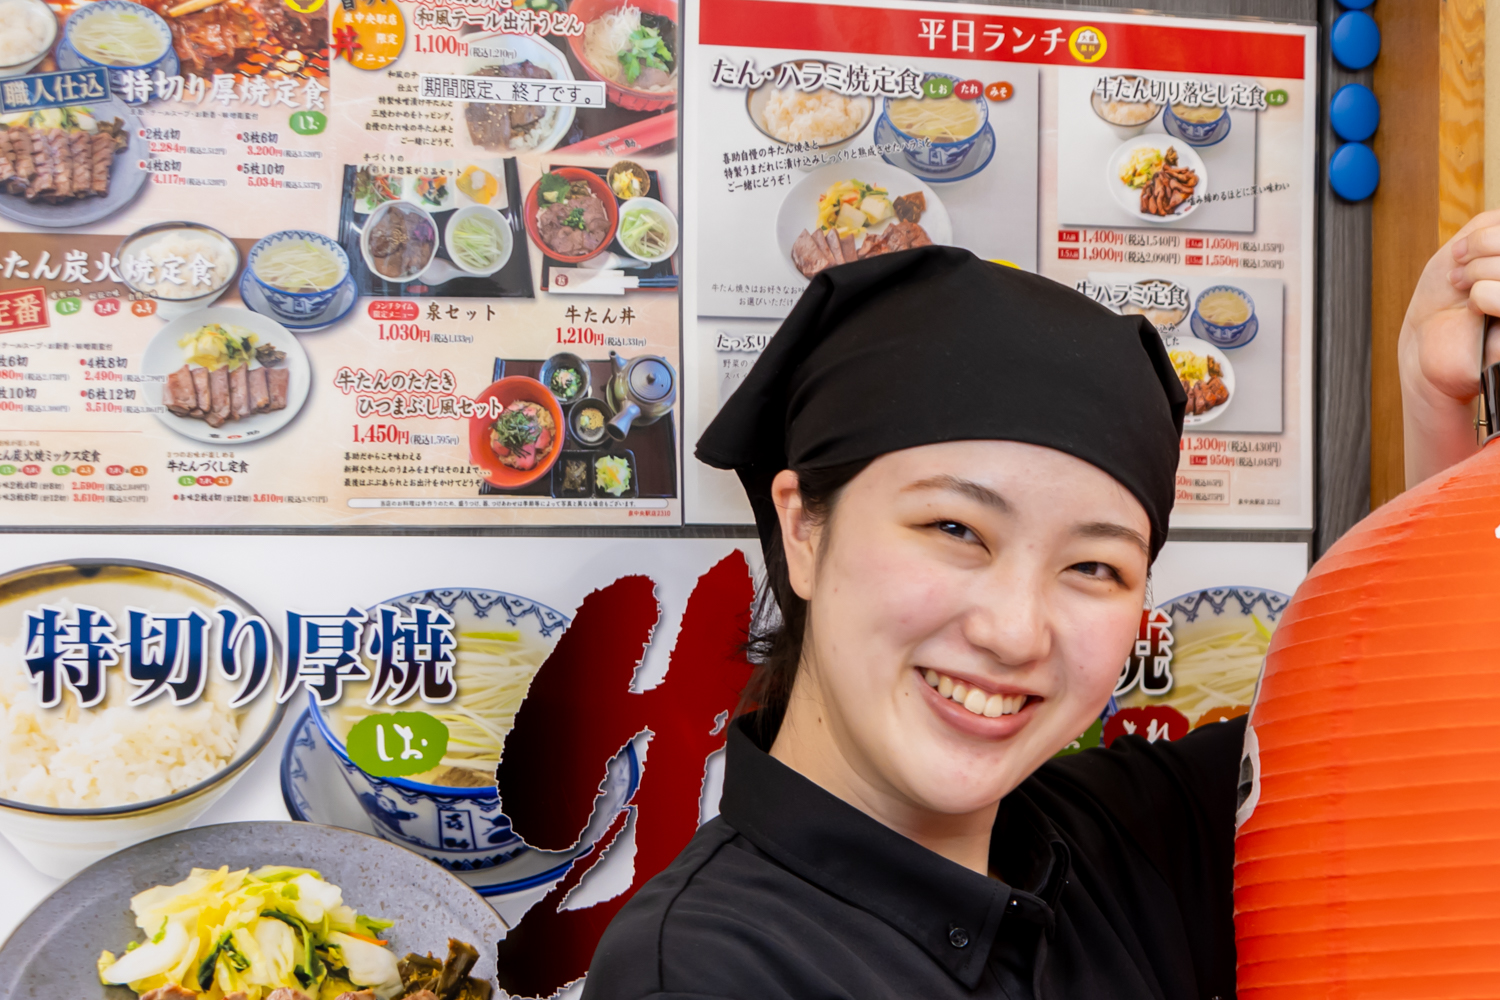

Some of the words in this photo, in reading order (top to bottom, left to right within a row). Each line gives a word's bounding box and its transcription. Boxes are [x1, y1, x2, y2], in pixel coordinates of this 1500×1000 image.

[416, 8, 583, 35] 和風テール出汁うどん
[415, 34, 469, 56] 1,100円
[918, 17, 1066, 56] 平日ランチ
[711, 58, 922, 96] たん・ハラミ焼定食
[4, 71, 105, 106] 職人仕込
[122, 69, 329, 109] 特切り厚焼定食
[424, 77, 592, 106] 期間限定、終了です。
[1096, 77, 1266, 108] 牛たん切り落とし定食
[1082, 230, 1124, 246] 1,400円
[1205, 238, 1239, 251] 1,050円
[1082, 247, 1124, 263] 1,900円
[1205, 254, 1239, 267] 1,550円
[0, 249, 215, 287] たん炭火焼定食
[426, 302, 496, 322] 泉セット
[564, 305, 636, 326] 牛たん丼
[378, 323, 431, 343] 1,030円
[555, 327, 604, 347] 1,210円
[717, 334, 771, 350] たっぷり
[337, 369, 455, 394] 牛たんのたたき
[358, 397, 501, 418] ひつまぶし風セット
[352, 423, 409, 444] 1,450円
[1187, 437, 1227, 451] 1,300円
[167, 459, 249, 474] 牛たんづくし定食
[1209, 454, 1236, 466] 950円
[24, 605, 458, 708] 特切り厚焼
